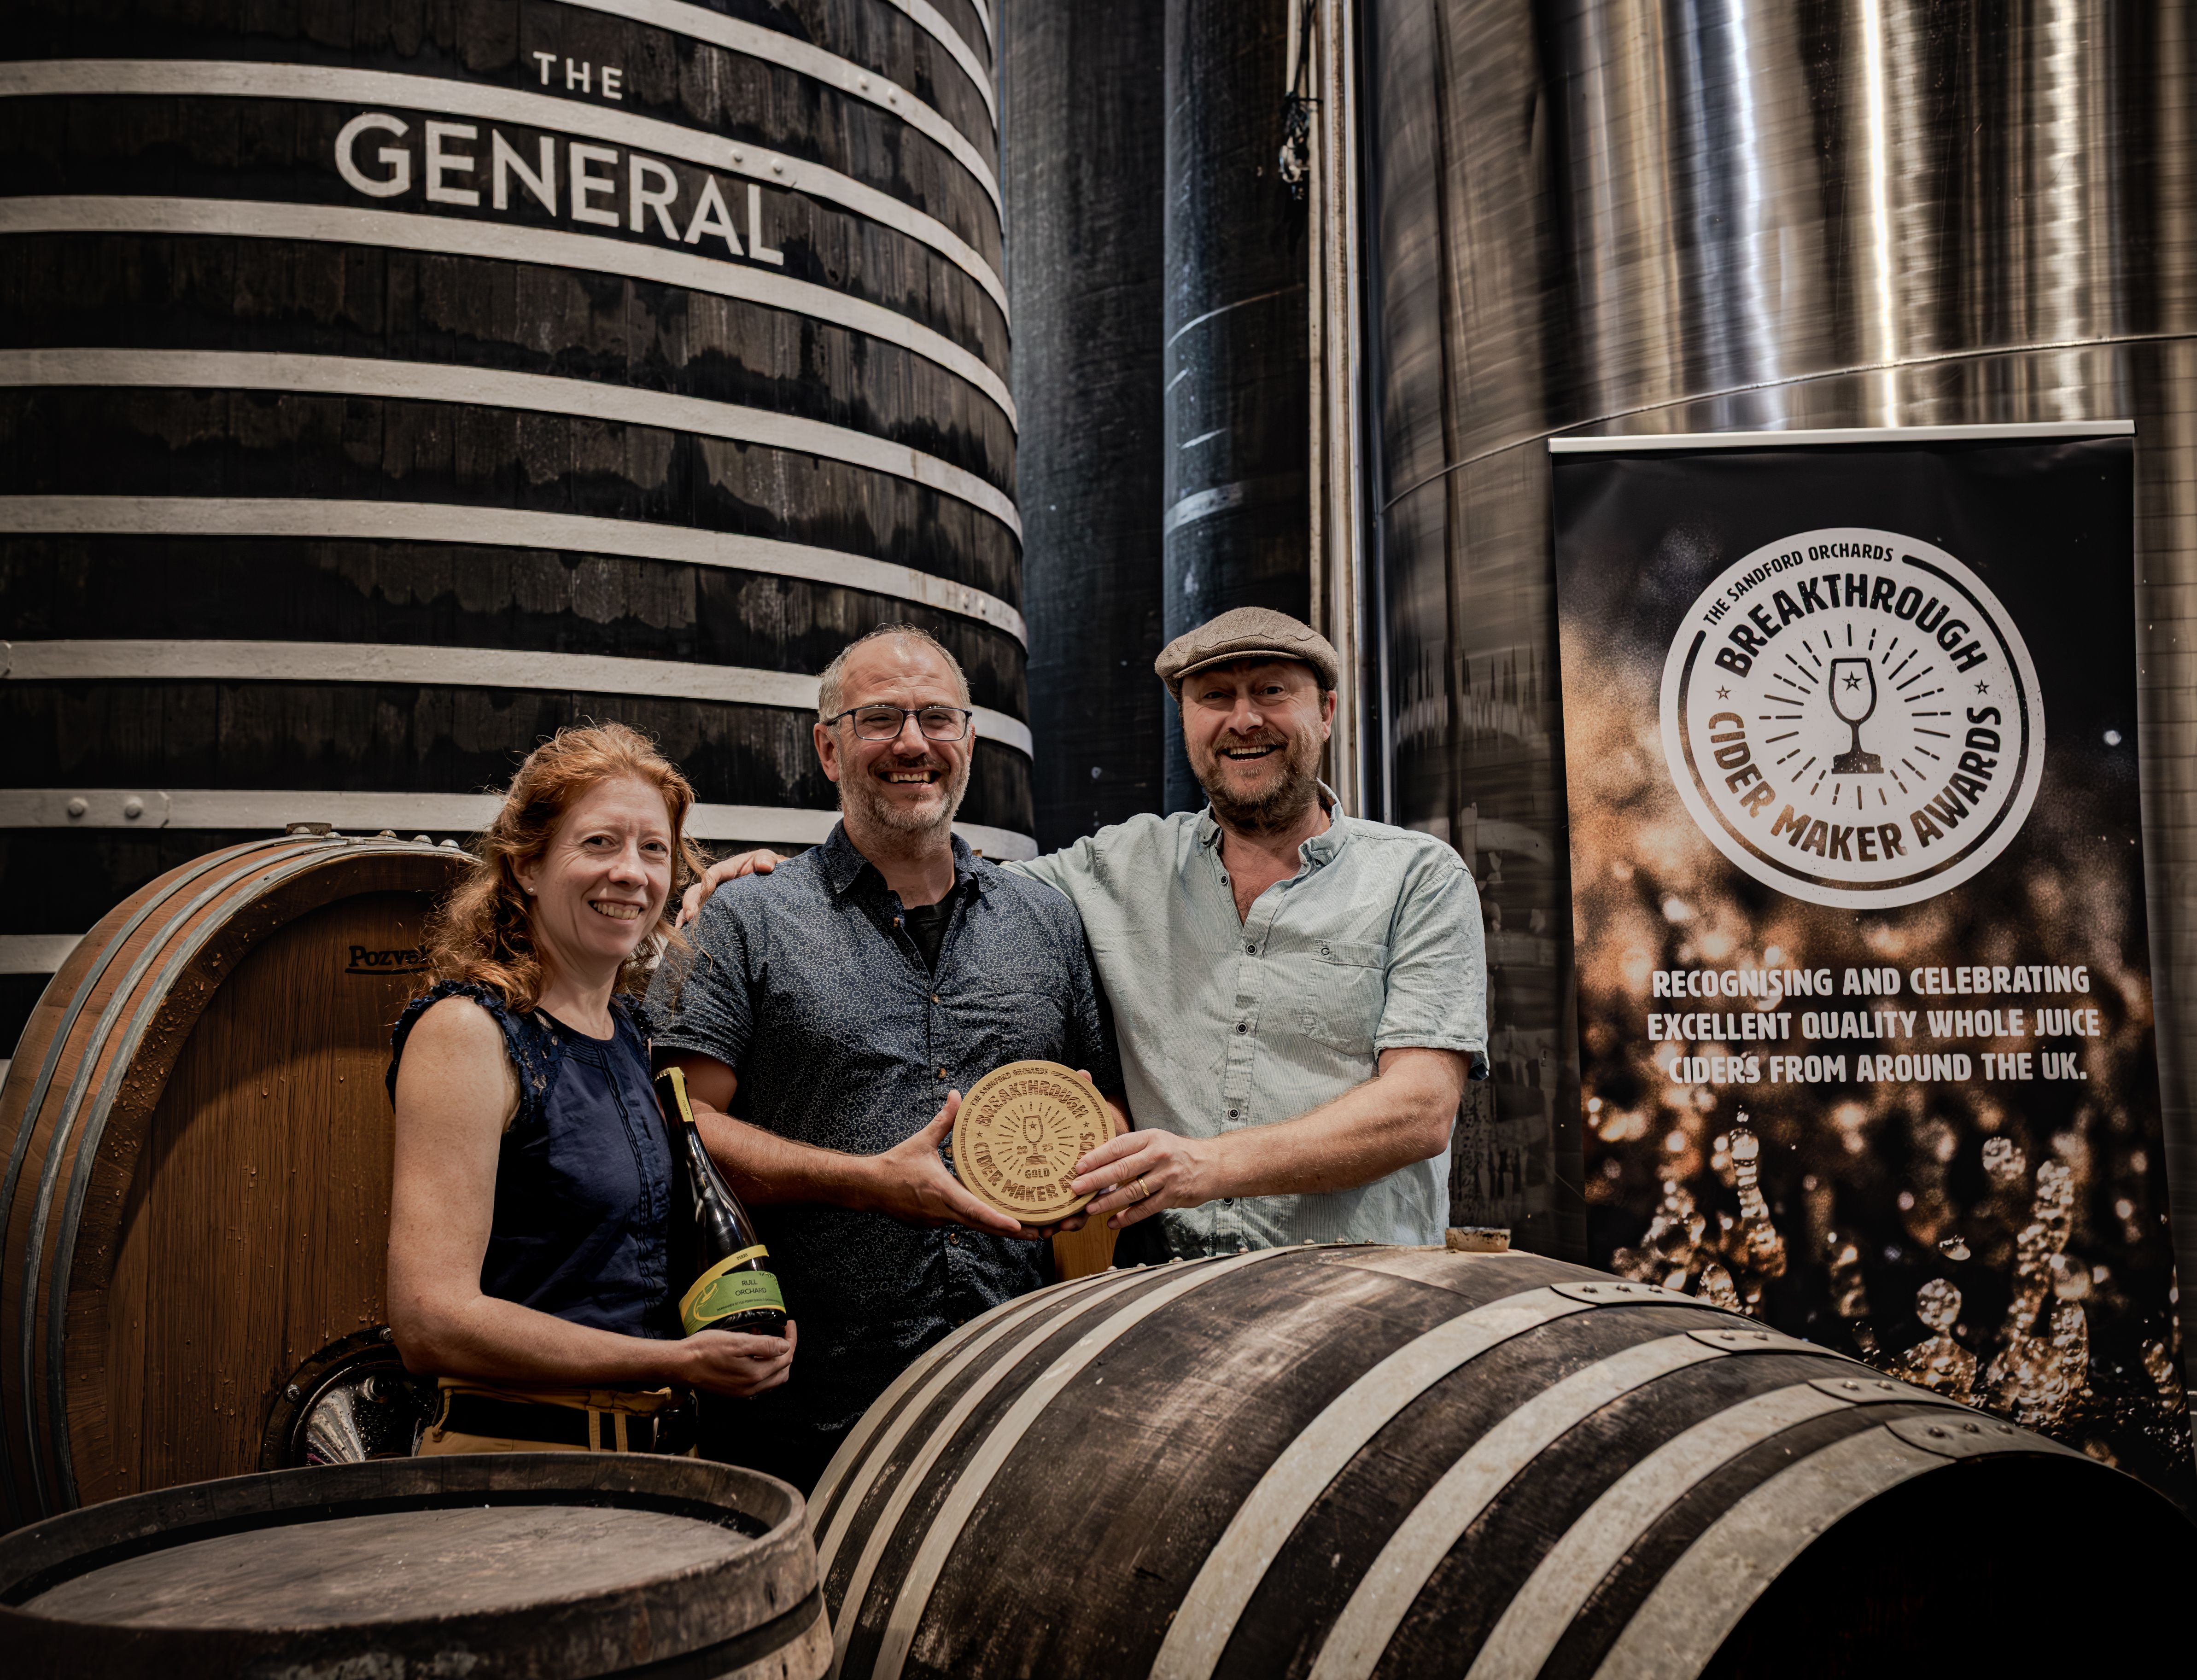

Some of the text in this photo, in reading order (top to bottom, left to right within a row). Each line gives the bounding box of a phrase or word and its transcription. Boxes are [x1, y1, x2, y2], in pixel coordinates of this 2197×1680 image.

[533, 51, 623, 100] THE
[334, 112, 783, 266] GENERAL
[1703, 543, 1893, 627] THE SANDFORD ORCHARDS
[1714, 573, 1988, 678] BREAKTHROUGH
[1708, 706, 2002, 862] CIDER MAKER AWARDS
[1652, 966, 2090, 998] RECOGNISING AND CELEBRATING
[1648, 1009, 2101, 1041] EXCELLENT QUALITY WHOLE JUICE
[970, 1068, 1049, 1106] THE SANDFORD ORCHARDS
[1668, 1053, 2087, 1084] CIDERS FROM AROUND THE UK.
[975, 1079, 1089, 1127] BREAKTHROUGH
[973, 1142, 1004, 1187] CIDER
[1001, 1179, 1059, 1202] MAKER
[1024, 1168, 1050, 1179] GOLD
